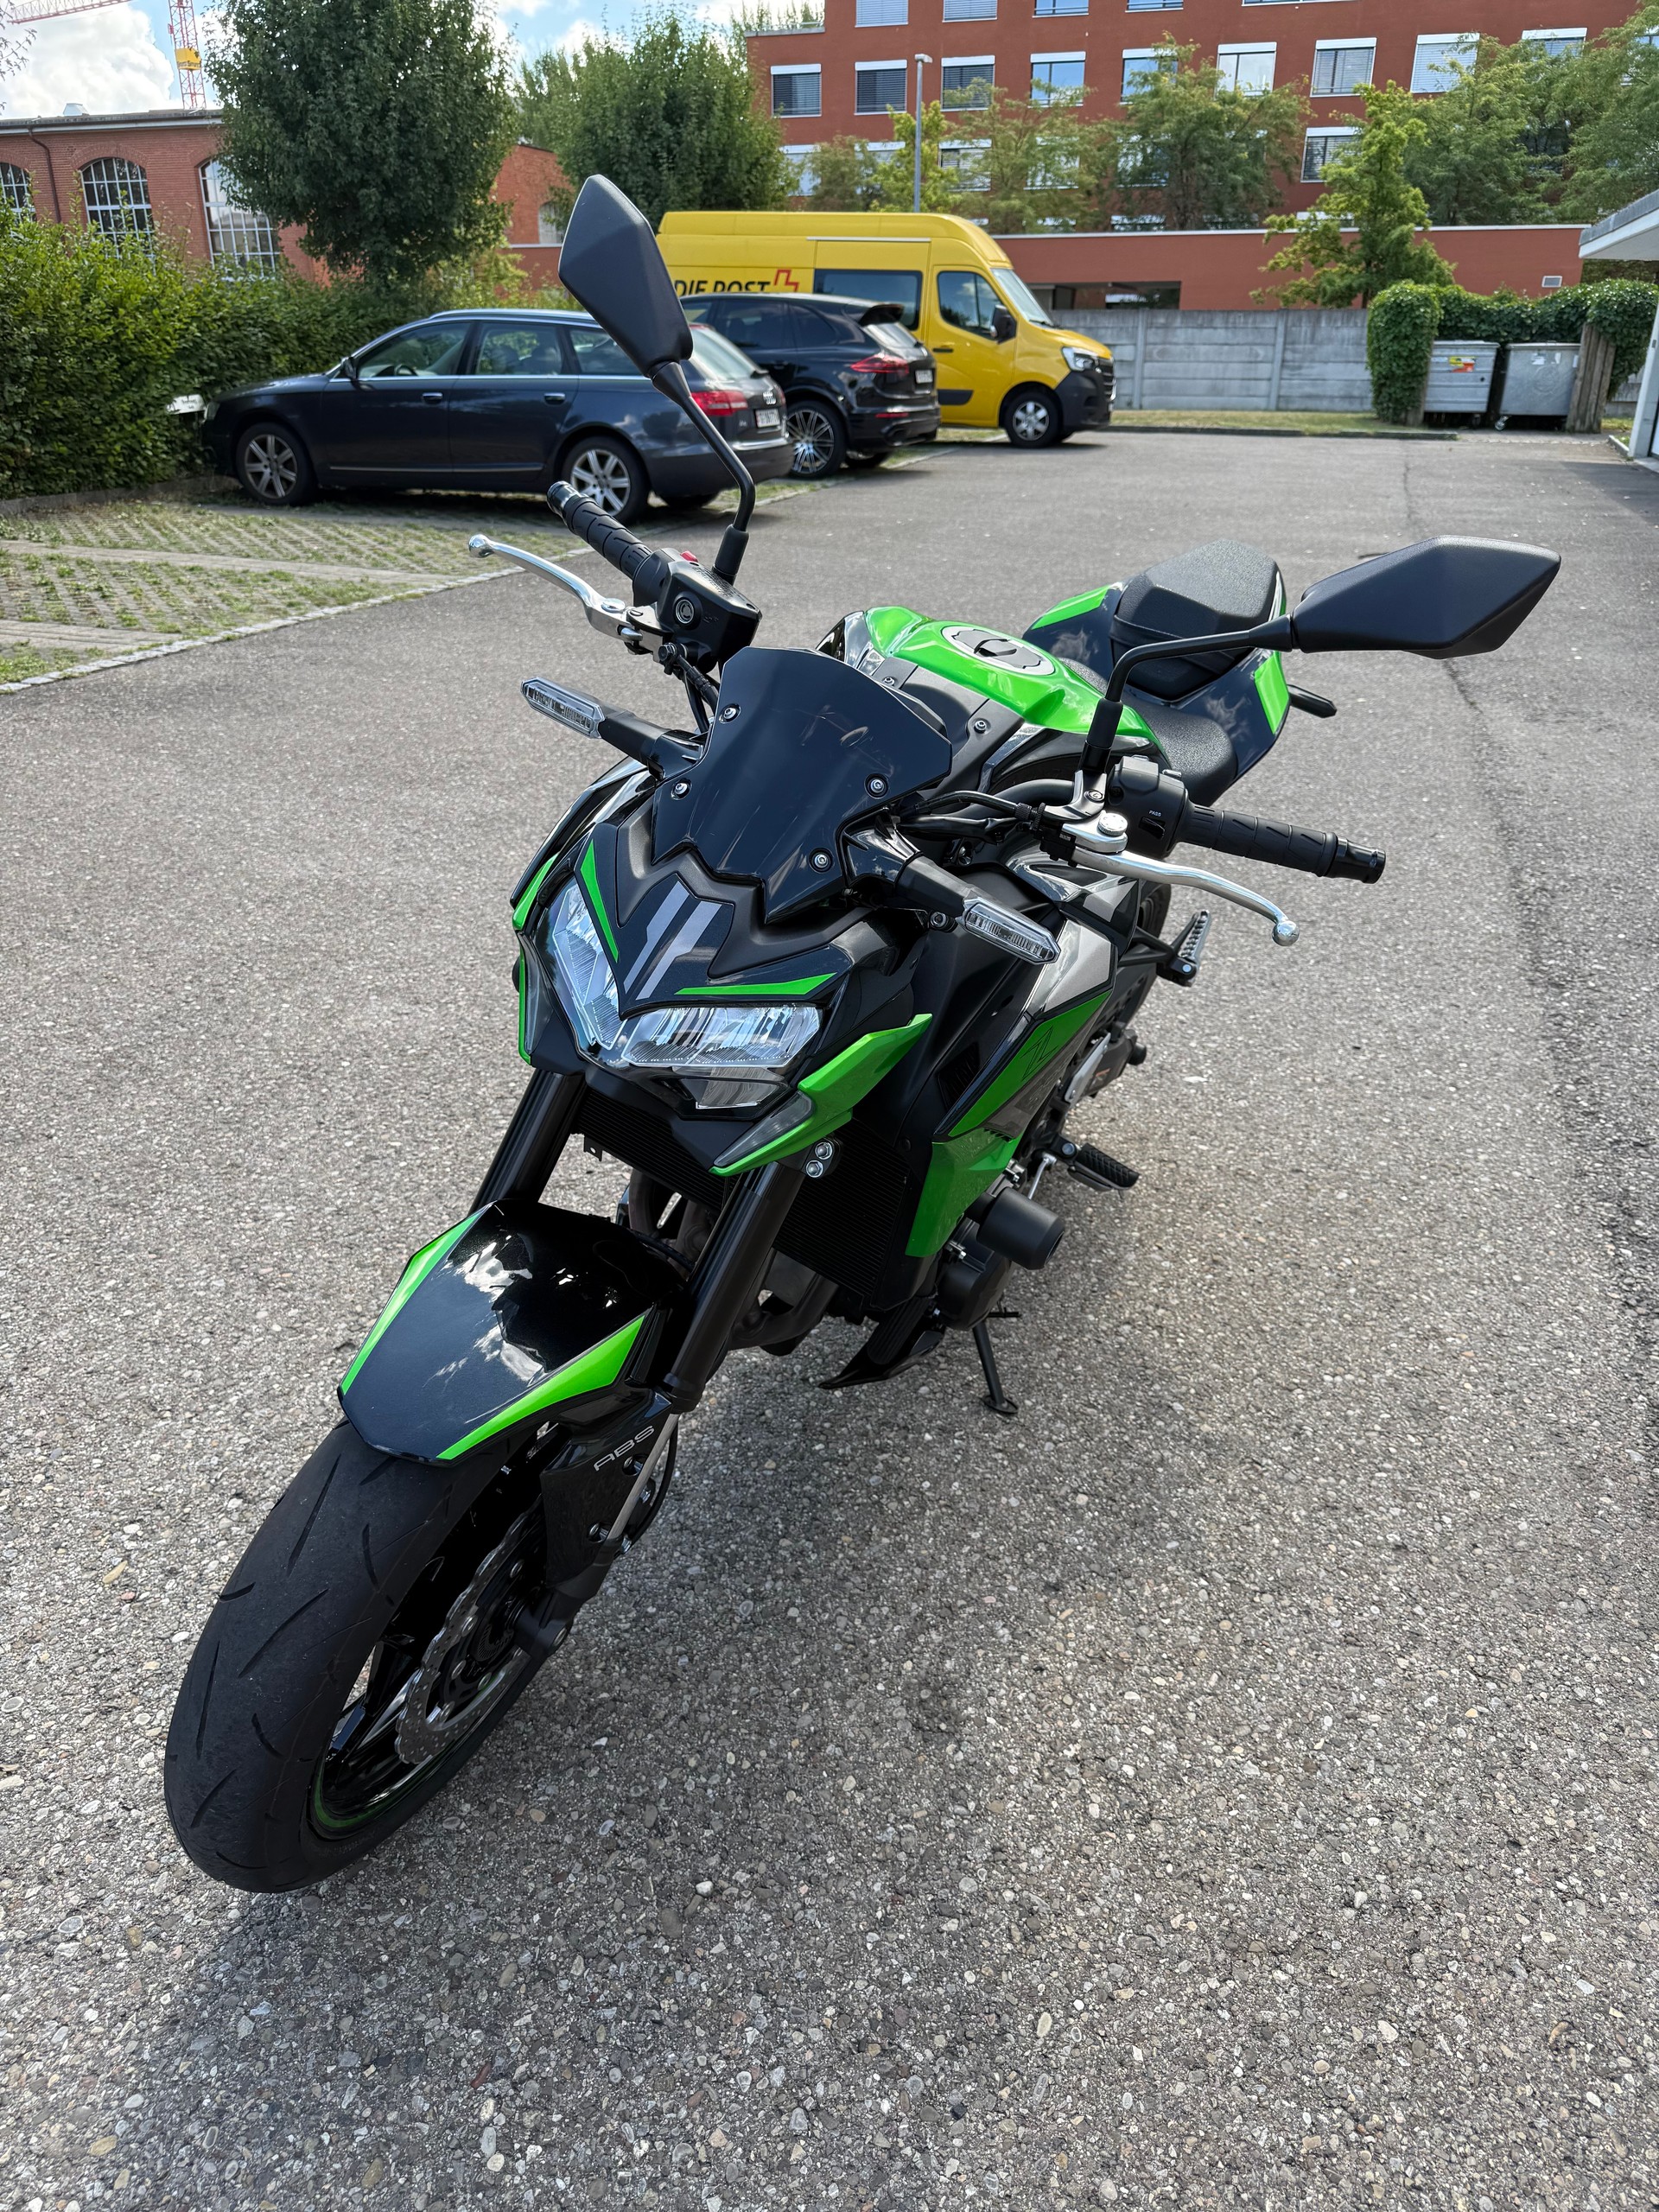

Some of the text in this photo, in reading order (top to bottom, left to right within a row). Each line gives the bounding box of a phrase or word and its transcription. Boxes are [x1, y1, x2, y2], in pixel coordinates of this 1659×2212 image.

[674, 280, 771, 296] DIE POST
[594, 1425, 655, 1471] ABS
